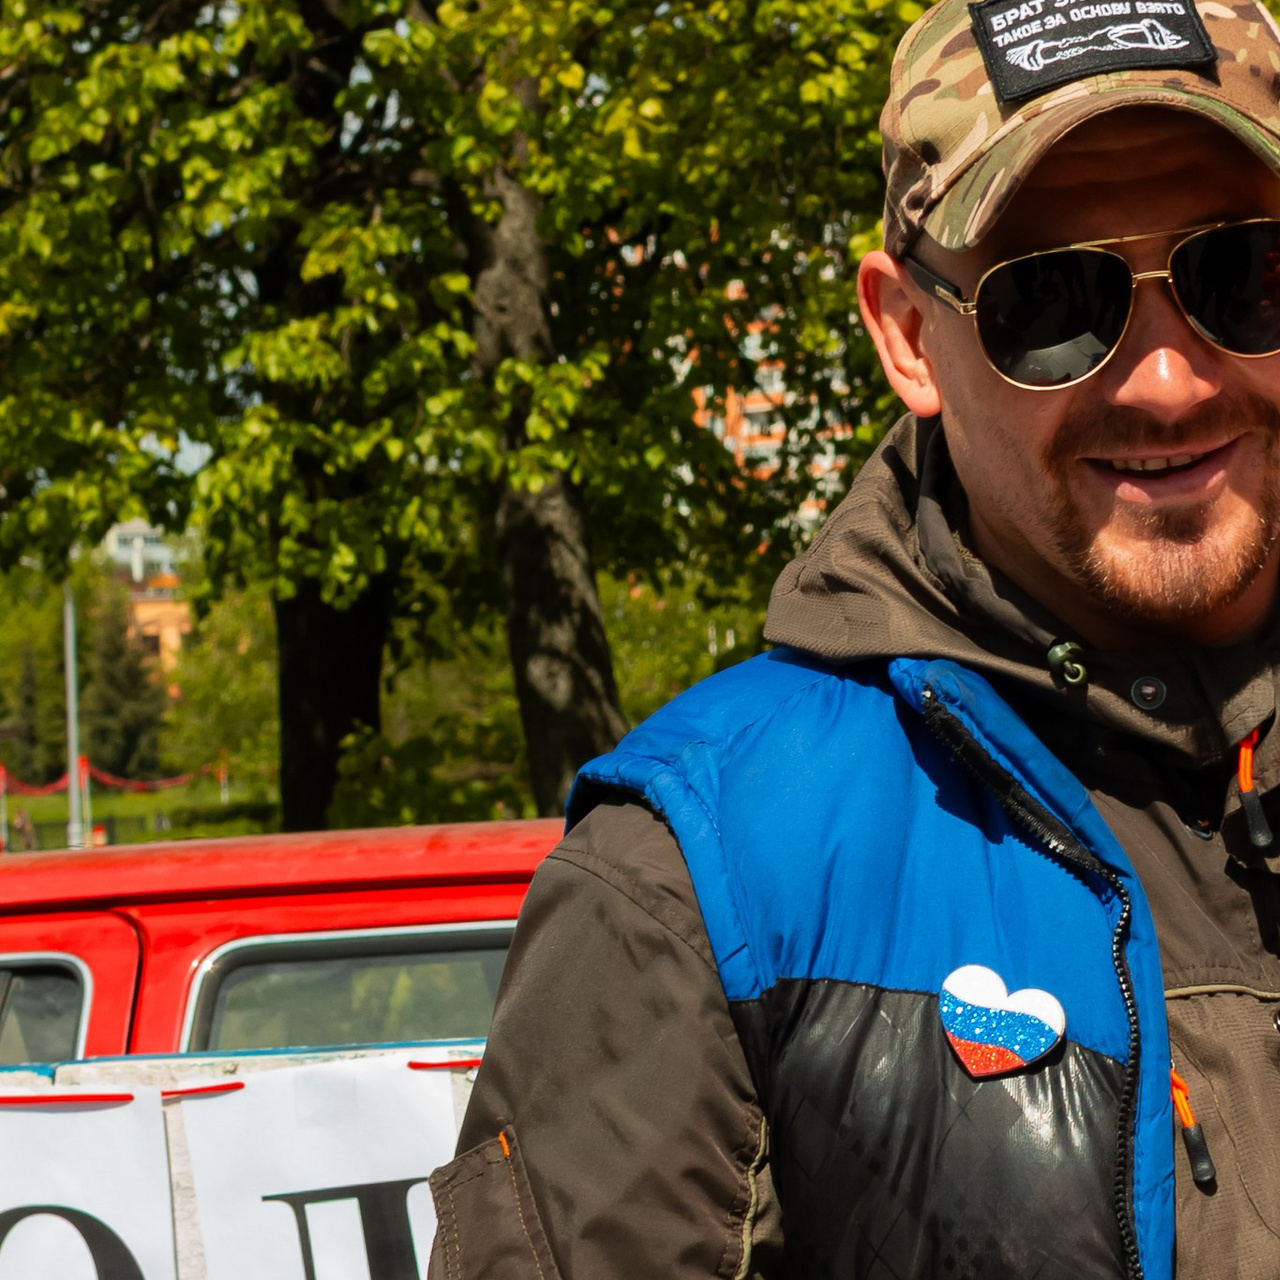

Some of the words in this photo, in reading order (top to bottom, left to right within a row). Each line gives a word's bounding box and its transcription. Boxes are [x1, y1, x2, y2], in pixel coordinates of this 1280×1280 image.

[992, 22, 1043, 48] ТАКОЕ
[1043, 12, 1068, 30] ЗА
[1069, 1, 1131, 22] ОСНОВУ
[1135, 2, 1185, 16] ВЗЯТО
